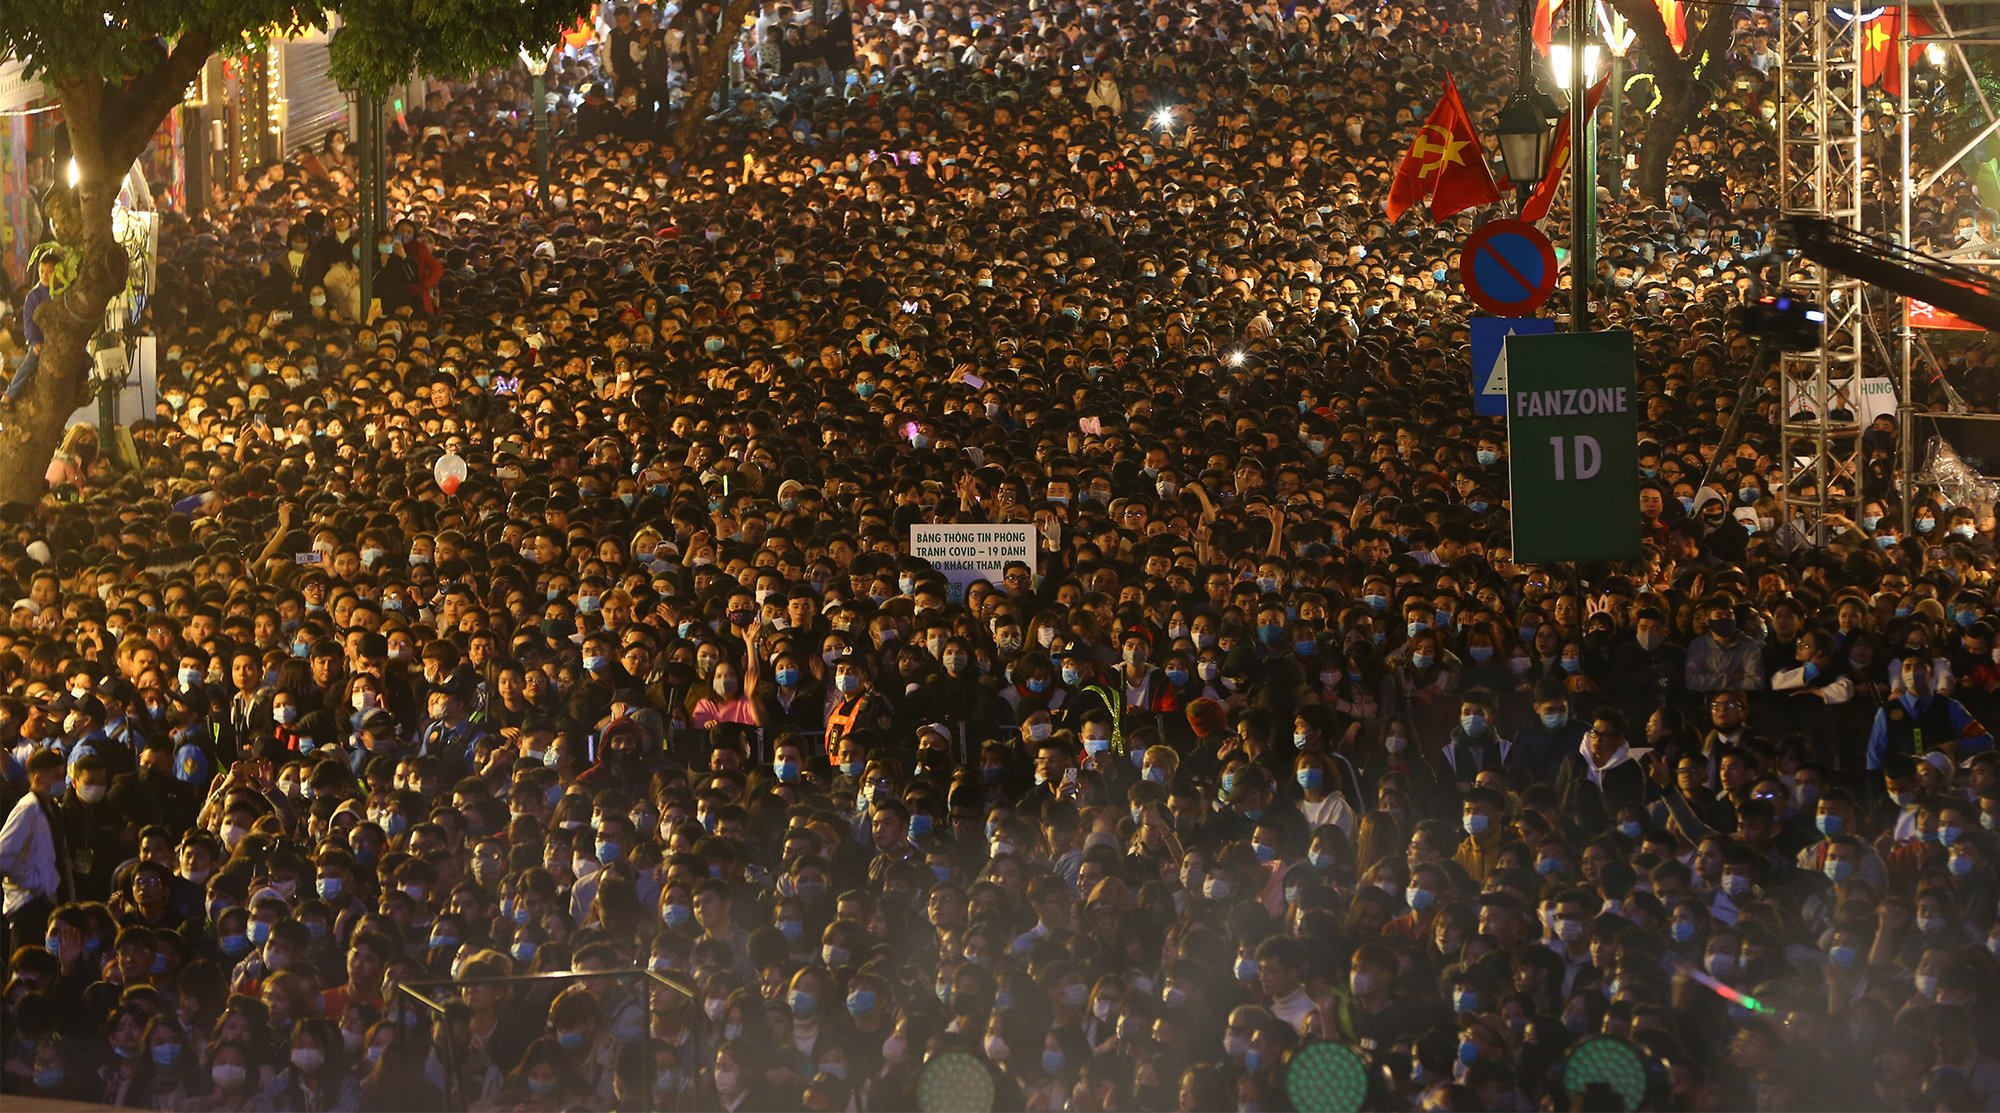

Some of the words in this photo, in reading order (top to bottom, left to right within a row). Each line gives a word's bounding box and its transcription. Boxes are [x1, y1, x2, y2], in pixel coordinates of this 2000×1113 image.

[1861, 382, 1892, 395] HUNG
[1517, 387, 1627, 417] FANZONE
[1549, 435, 1601, 480] 1D
[944, 531, 974, 542] THÔNG
[977, 533, 991, 542] TIN
[949, 547, 976, 556] COVID
[988, 547, 998, 556] 19
[930, 561, 941, 570] HO
[976, 560, 1001, 570] THAM
